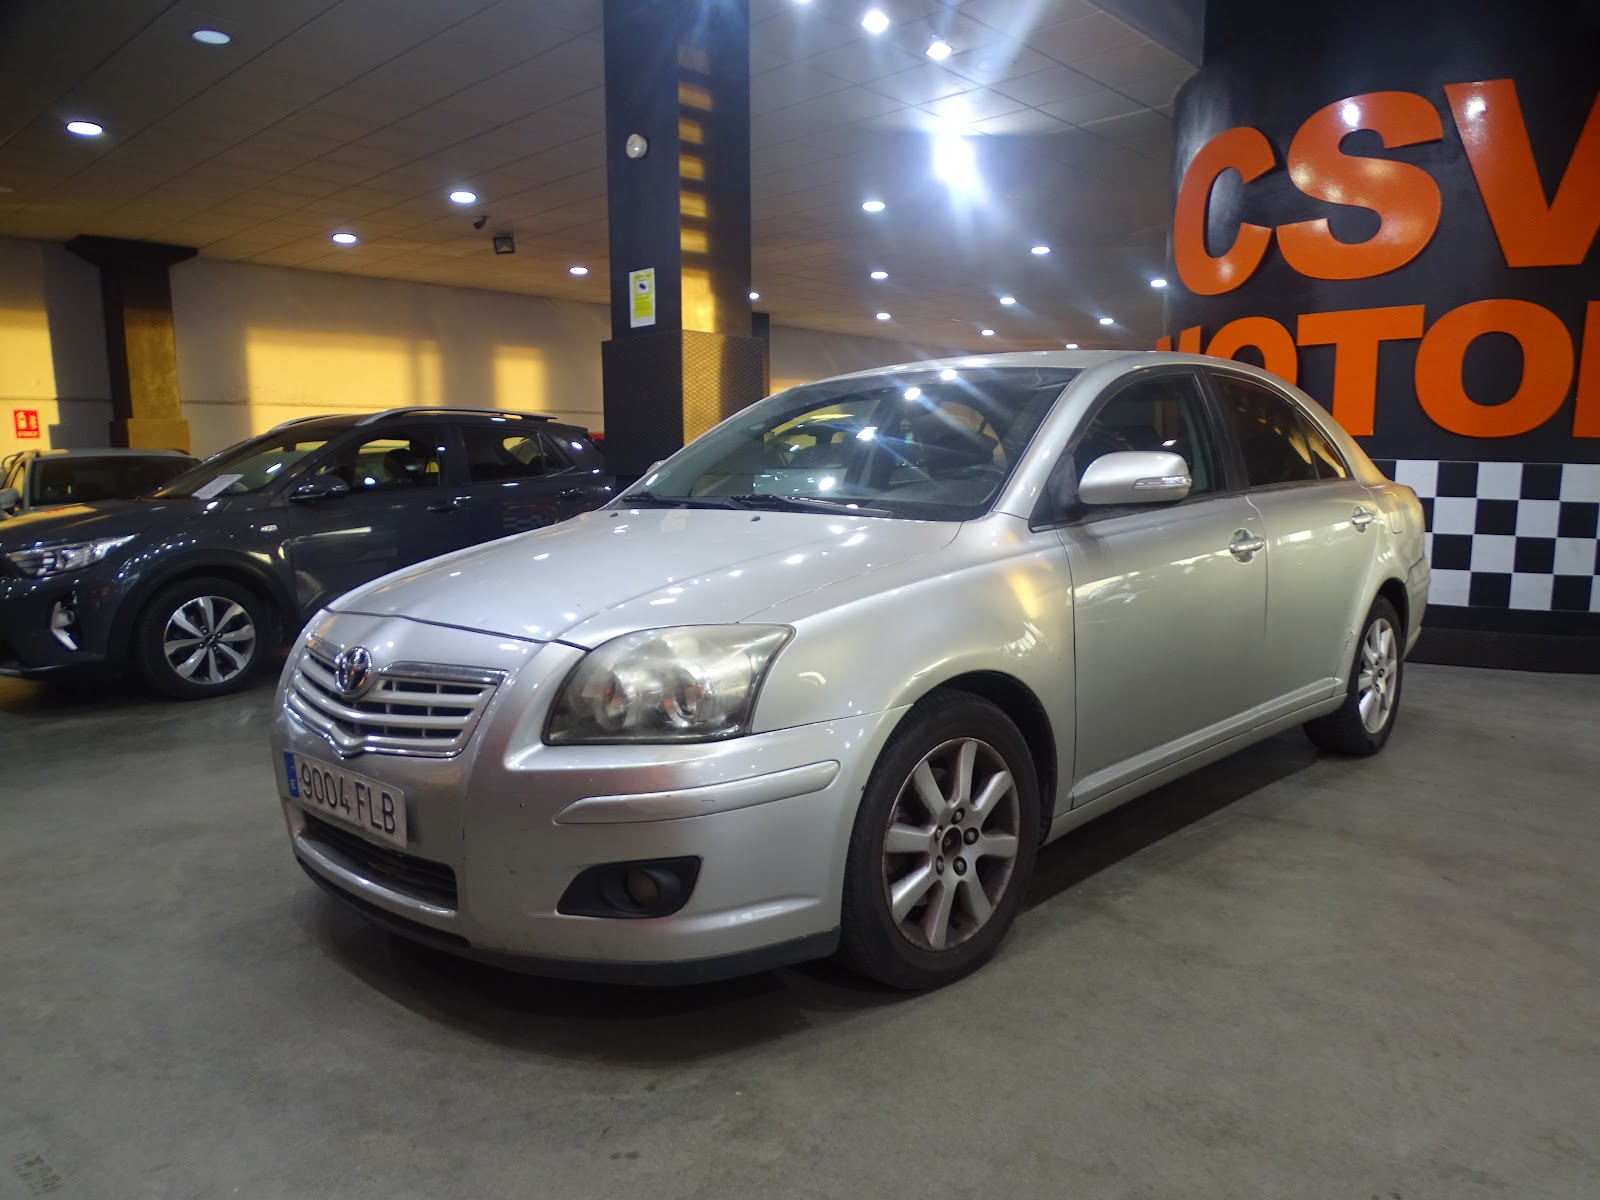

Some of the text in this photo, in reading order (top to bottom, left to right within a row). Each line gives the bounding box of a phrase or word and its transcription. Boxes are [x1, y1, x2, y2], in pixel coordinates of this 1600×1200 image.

[1173, 78, 1600, 296] CSV
[1156, 299, 1600, 438] OTO
[301, 762, 396, 834] 9004 FLB
